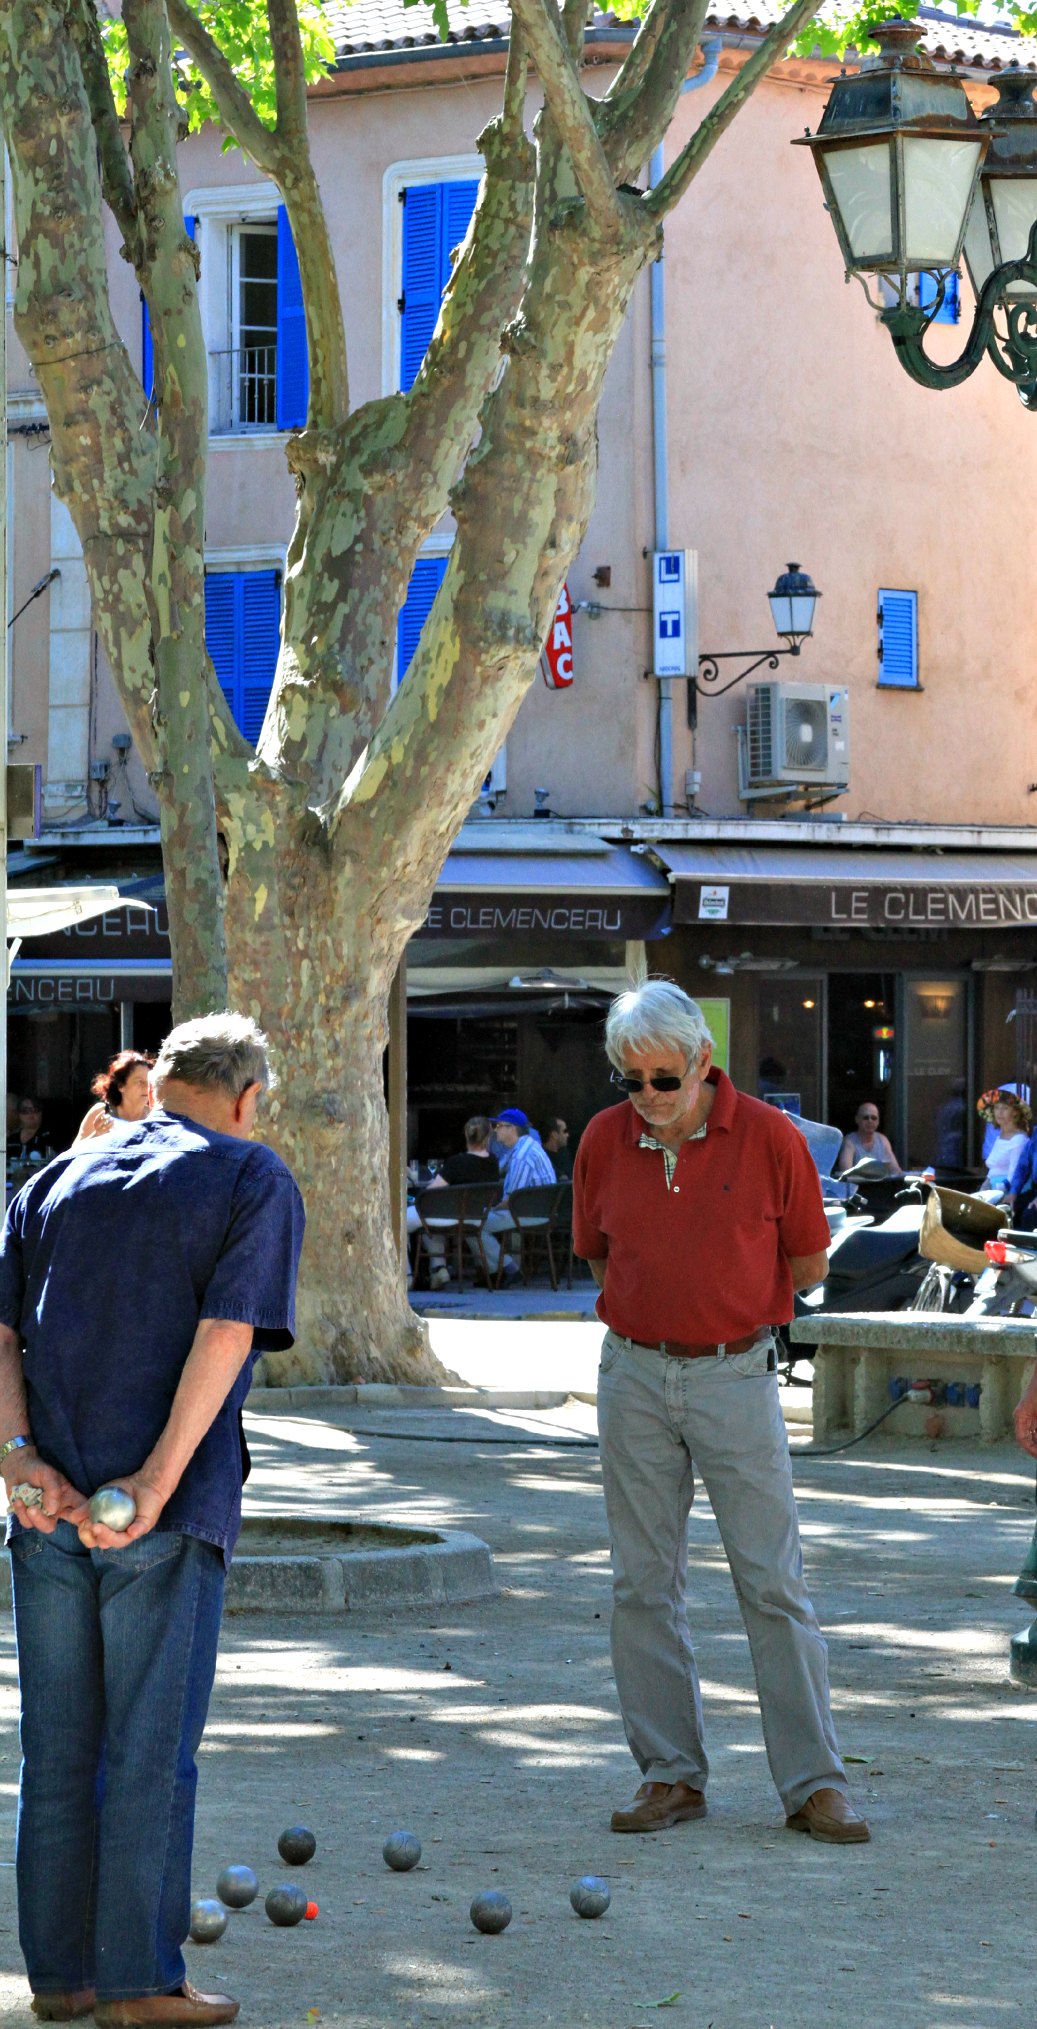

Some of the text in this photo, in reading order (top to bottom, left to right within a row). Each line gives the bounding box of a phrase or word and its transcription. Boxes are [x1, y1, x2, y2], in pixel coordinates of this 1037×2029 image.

[831, 891, 1037, 920] LE CLEMENC
[422, 907, 621, 930] E CLEMENCEAU
[7, 978, 115, 1001] NCEAU
